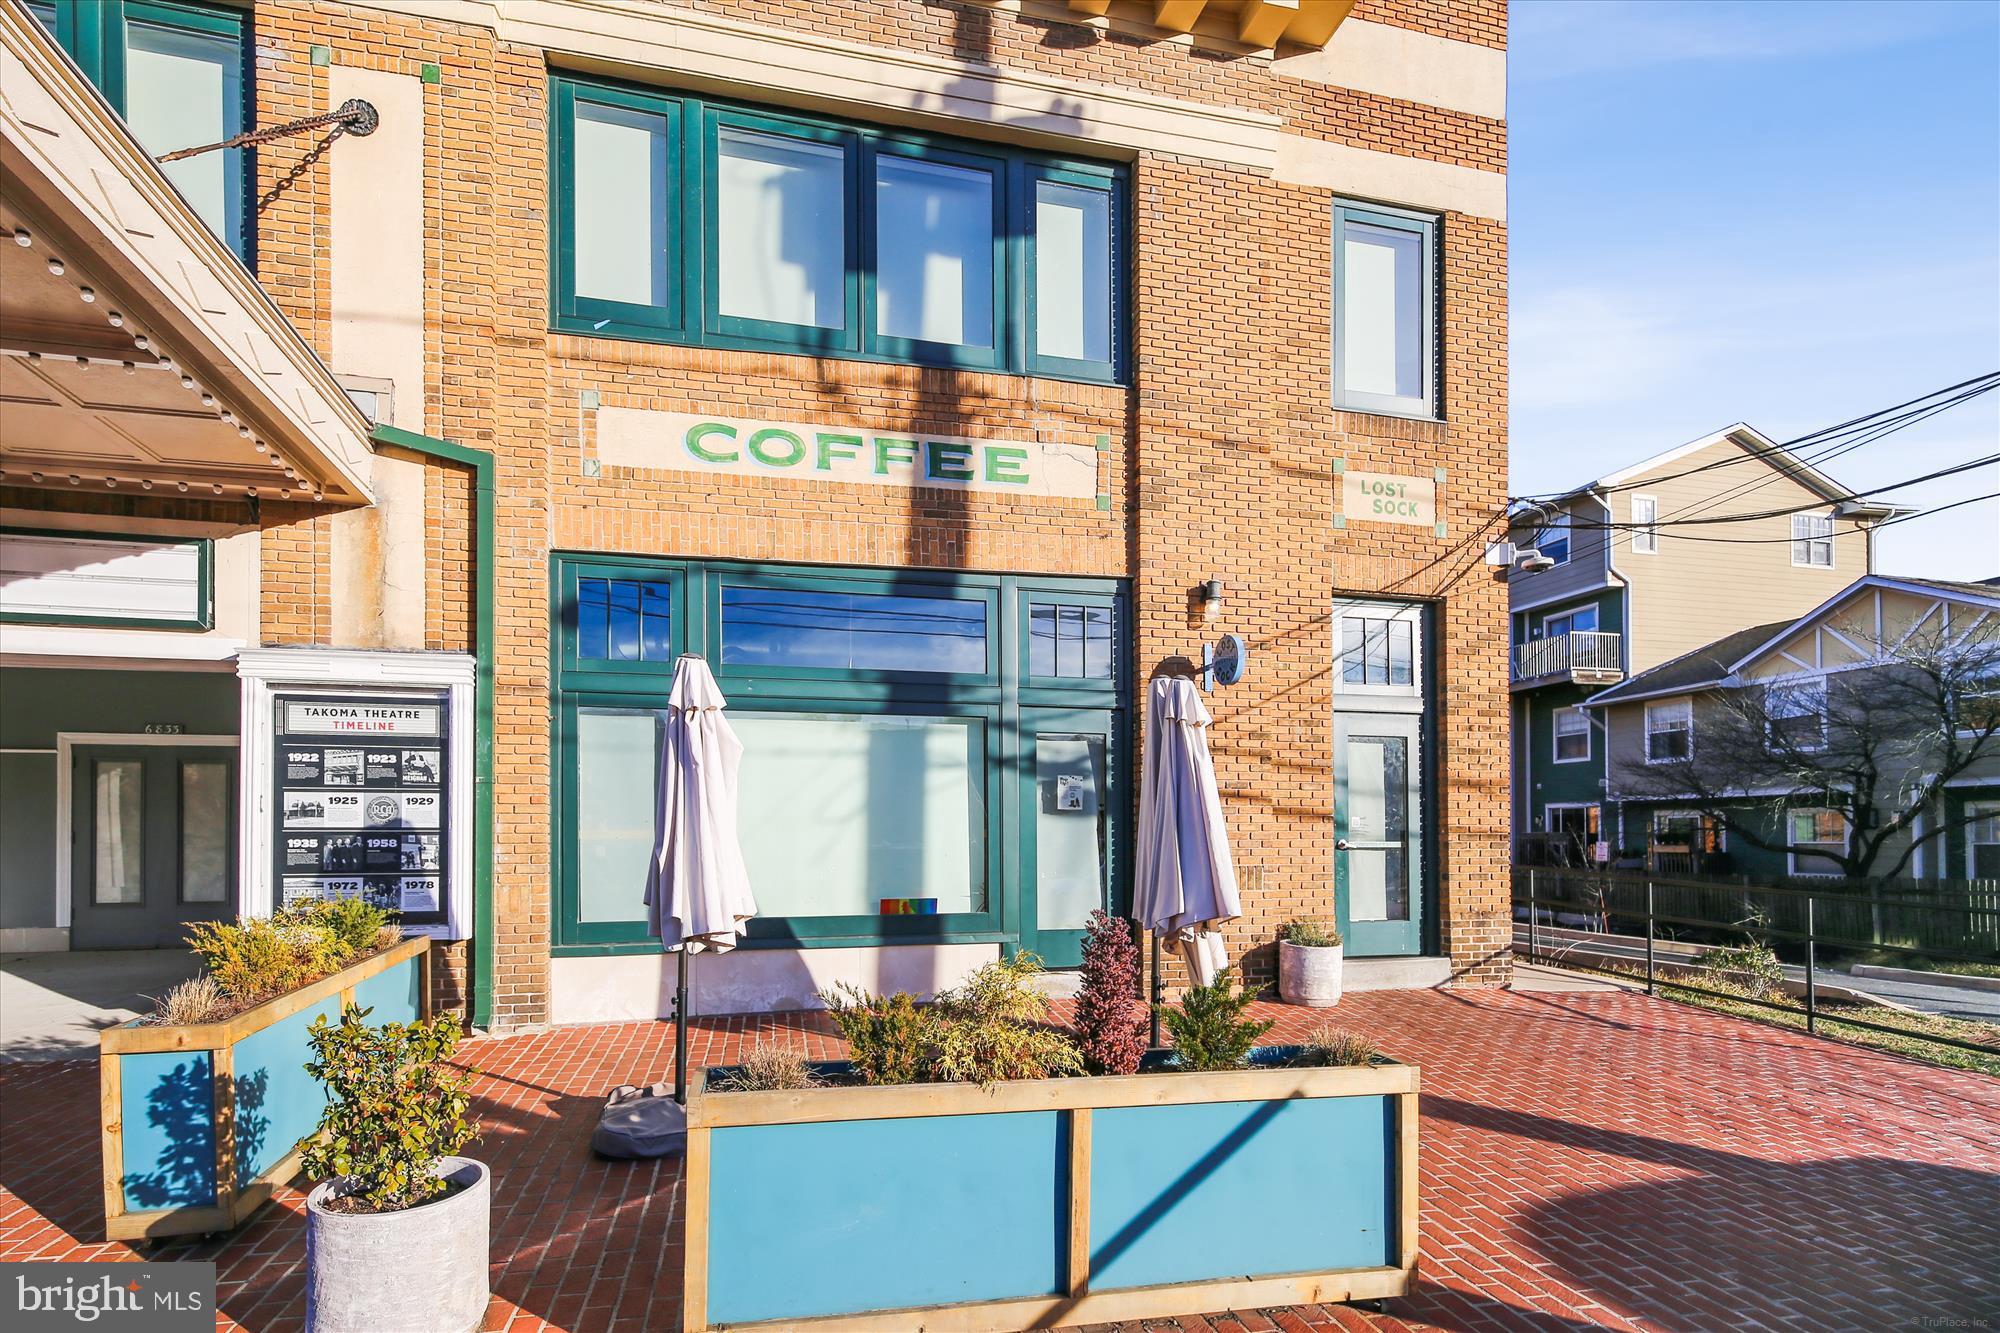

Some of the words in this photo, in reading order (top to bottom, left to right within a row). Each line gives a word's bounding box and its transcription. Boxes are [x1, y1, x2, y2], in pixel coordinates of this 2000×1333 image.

[682, 422, 1030, 485] COFFEE
[1361, 480, 1407, 498] LOST
[1372, 498, 1418, 517] SOCK
[304, 707, 358, 717] TAKOMA
[364, 709, 420, 719] THEATRE
[333, 721, 395, 731] TIMELINE
[287, 752, 320, 762] 1922
[366, 754, 397, 764] 1923
[328, 796, 358, 805] 1925
[405, 797, 434, 806] 1929
[372, 804, 395, 816] RCA
[287, 838, 318, 848] 1935
[366, 838, 398, 848] 1958
[327, 881, 358, 890] 1972
[404, 880, 434, 890] 1978
